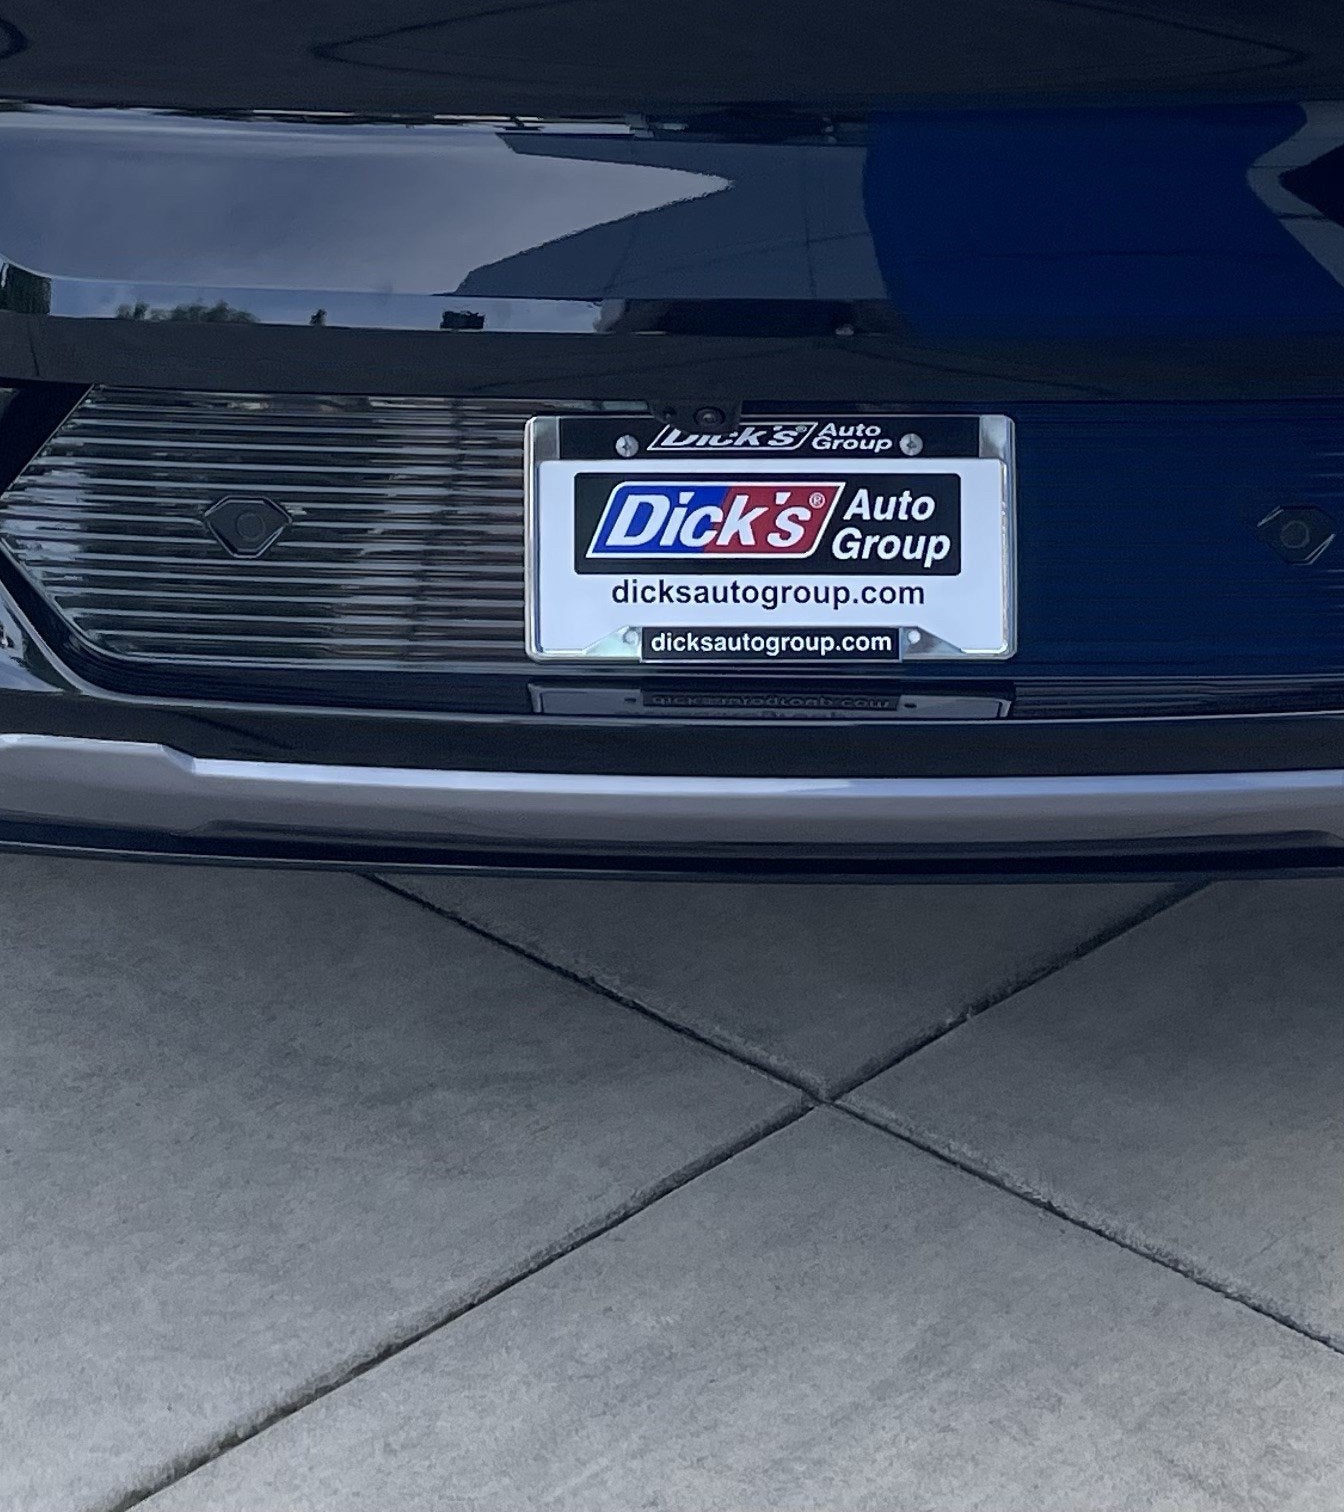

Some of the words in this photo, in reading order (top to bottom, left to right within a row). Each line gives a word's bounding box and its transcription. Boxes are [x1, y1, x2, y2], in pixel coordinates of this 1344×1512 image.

[811, 436, 893, 453] Group
[817, 422, 882, 437] Auto
[605, 491, 812, 548] Dick's
[843, 488, 936, 522] Auto
[831, 530, 951, 568] Group
[611, 579, 925, 610] dicksautogroup.com
[650, 633, 892, 656] dicksautogroup.com
